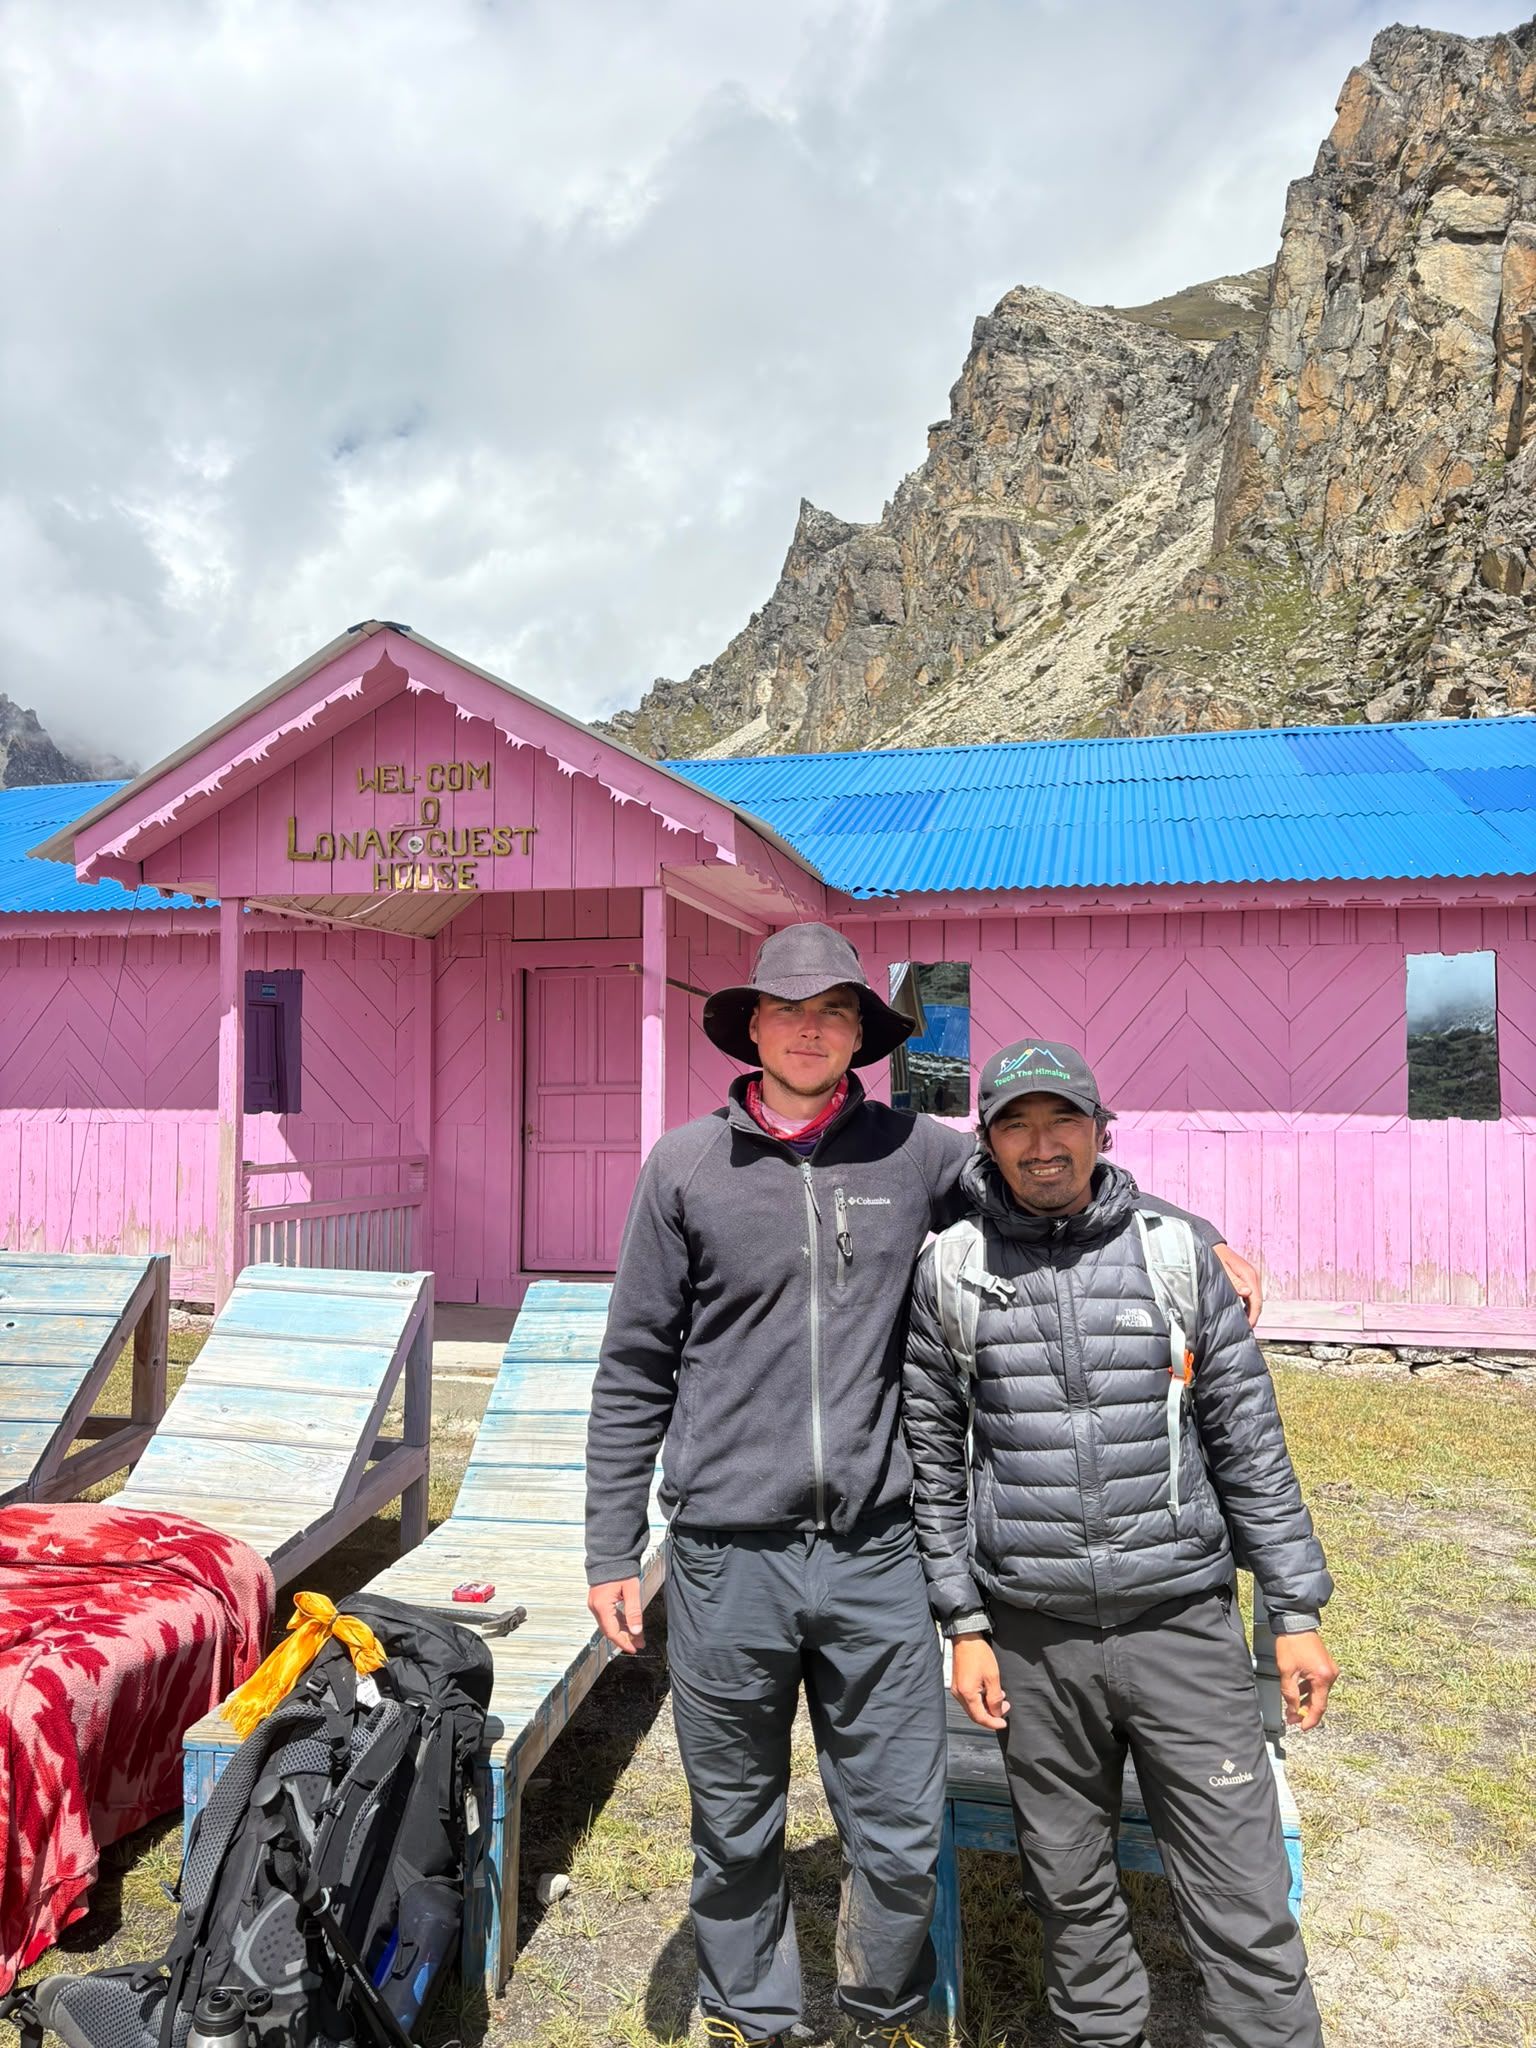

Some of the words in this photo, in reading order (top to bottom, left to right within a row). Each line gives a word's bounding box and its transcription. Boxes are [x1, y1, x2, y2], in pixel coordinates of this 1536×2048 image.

[287, 816, 408, 861] LONAK
[374, 862, 478, 890] HOUSE
[994, 1074, 1015, 1087] Touch
[856, 1197, 890, 1205] Columbia
[1209, 1772, 1254, 1787] Columbia
